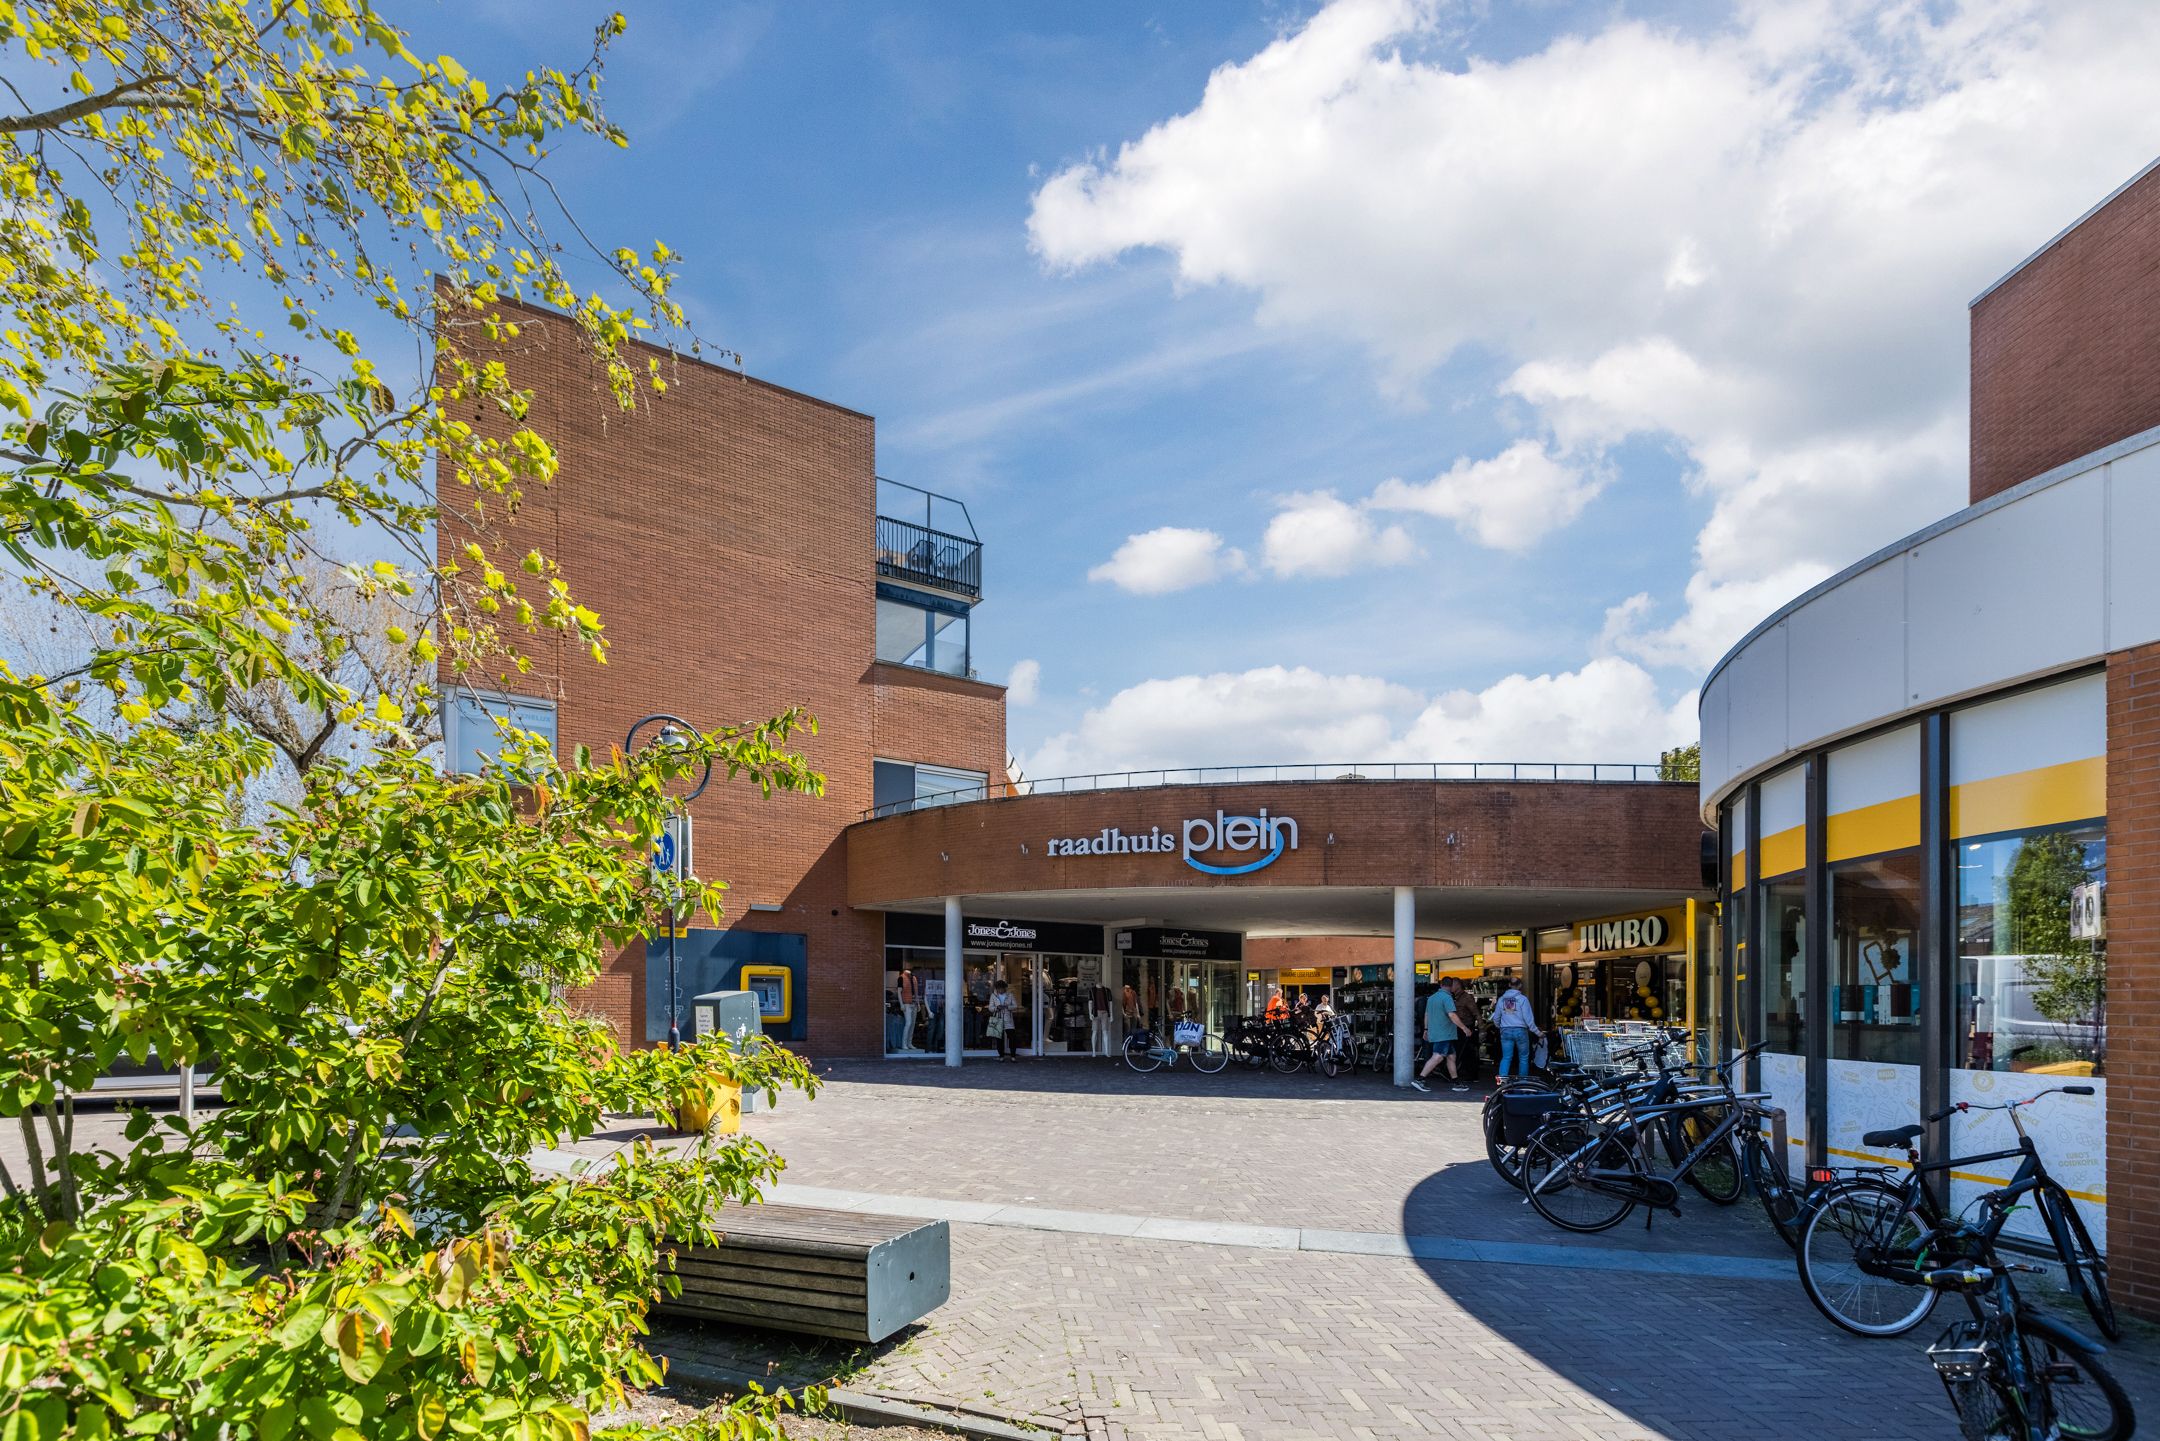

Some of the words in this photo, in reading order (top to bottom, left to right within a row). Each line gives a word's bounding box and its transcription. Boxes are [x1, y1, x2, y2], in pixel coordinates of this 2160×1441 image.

[1047, 826, 1175, 856] raadhuis
[1183, 808, 1298, 860] plein
[970, 940, 1033, 949] www.jonesenjones.nl
[1578, 916, 1662, 953] JUMBO
